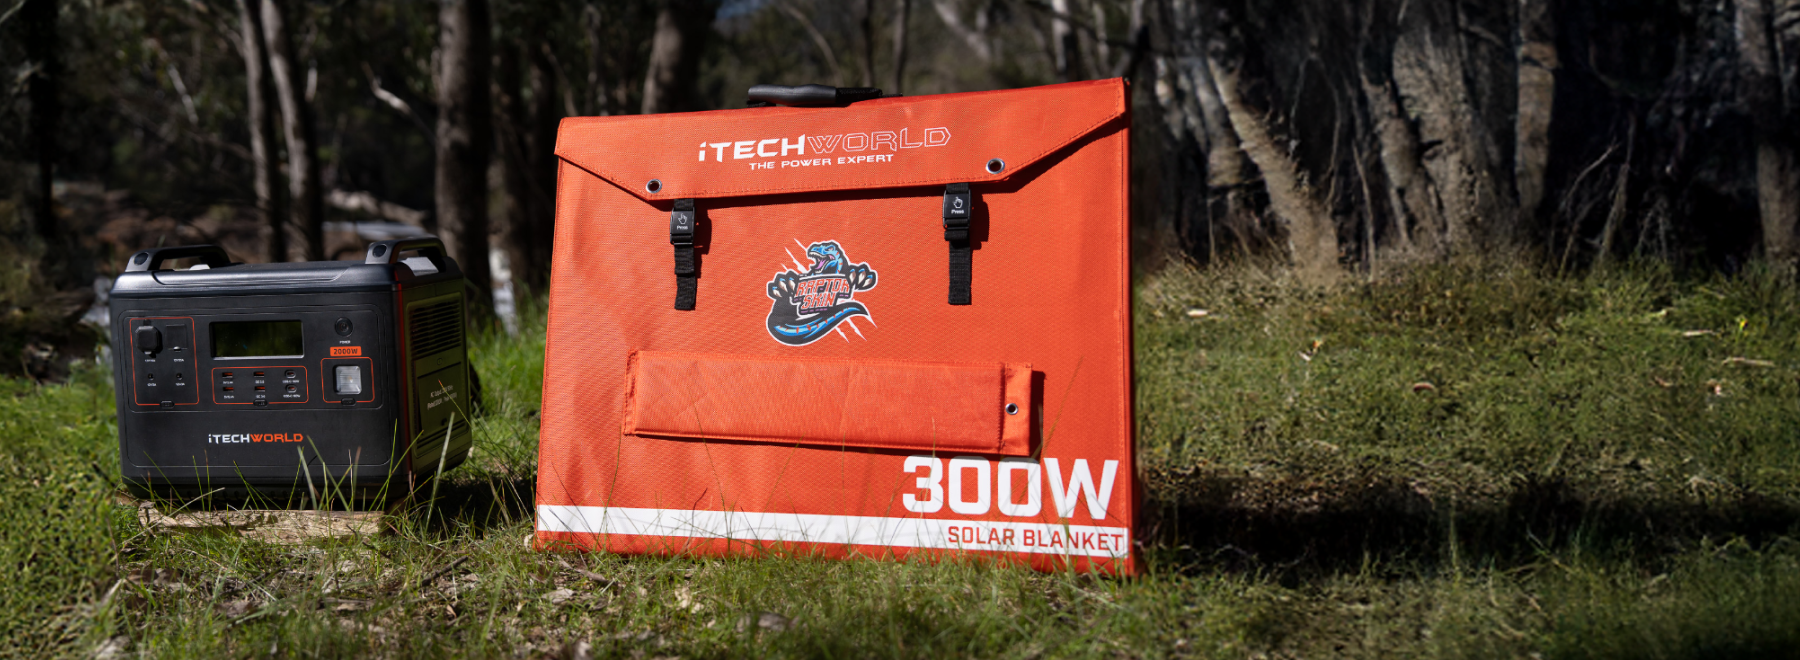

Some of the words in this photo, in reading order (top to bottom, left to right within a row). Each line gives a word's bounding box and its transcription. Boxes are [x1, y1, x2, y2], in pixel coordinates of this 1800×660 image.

[750, 161, 775, 171] THE
[781, 157, 832, 169] POWER
[837, 153, 894, 165] EXPERT
[794, 278, 851, 298] RAPTOR
[800, 292, 837, 310] SKIN
[902, 454, 1119, 520] 300W
[947, 525, 1015, 546] SOLAR
[1023, 528, 1124, 552] BLANKET
